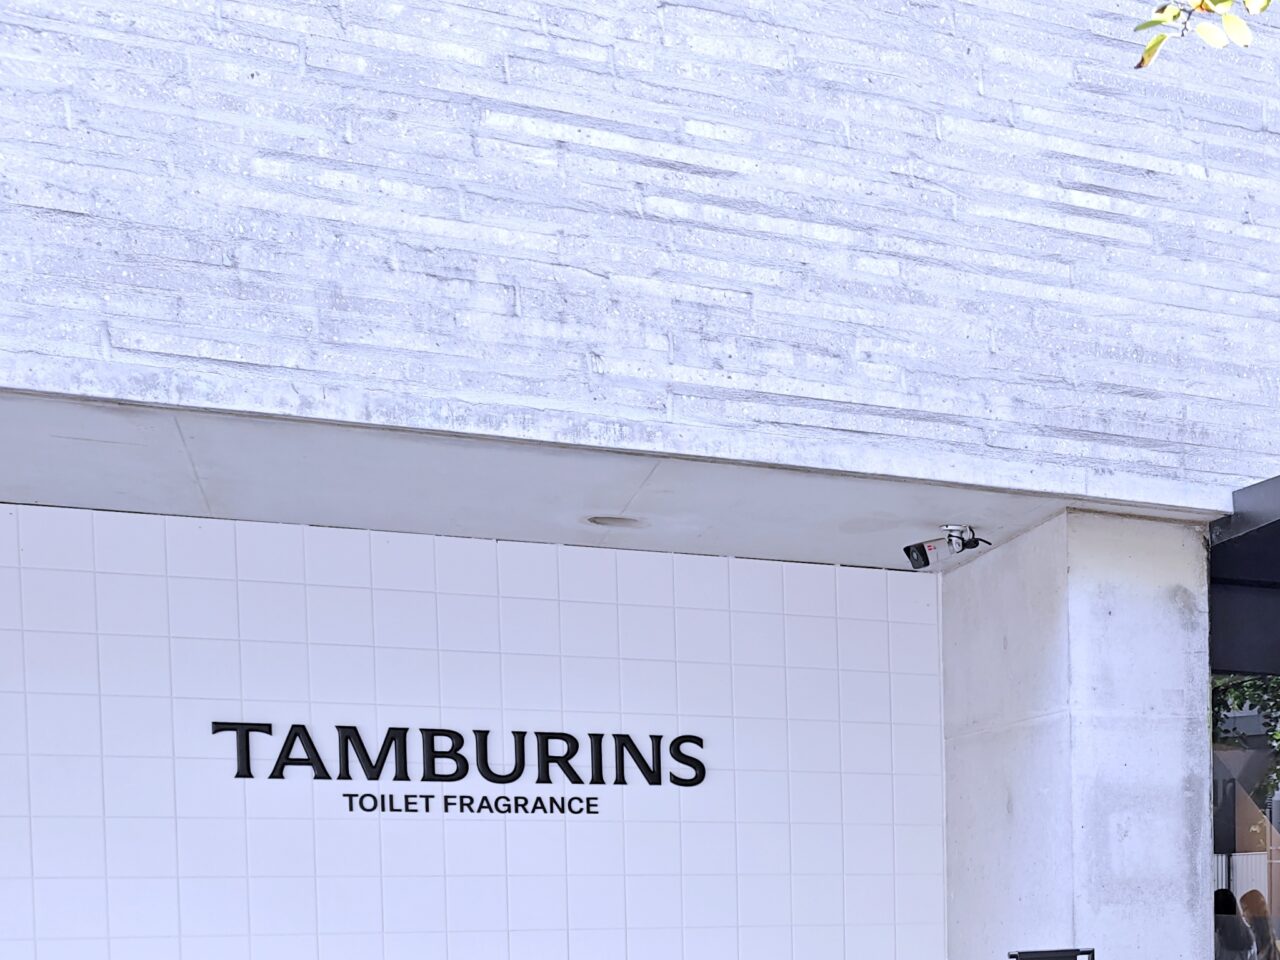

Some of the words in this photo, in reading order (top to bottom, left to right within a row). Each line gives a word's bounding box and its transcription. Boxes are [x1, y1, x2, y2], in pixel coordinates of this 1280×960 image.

[211, 721, 708, 788] TAMBURINS
[342, 793, 435, 814] TOILET
[443, 794, 600, 815] FRAGRANCE
